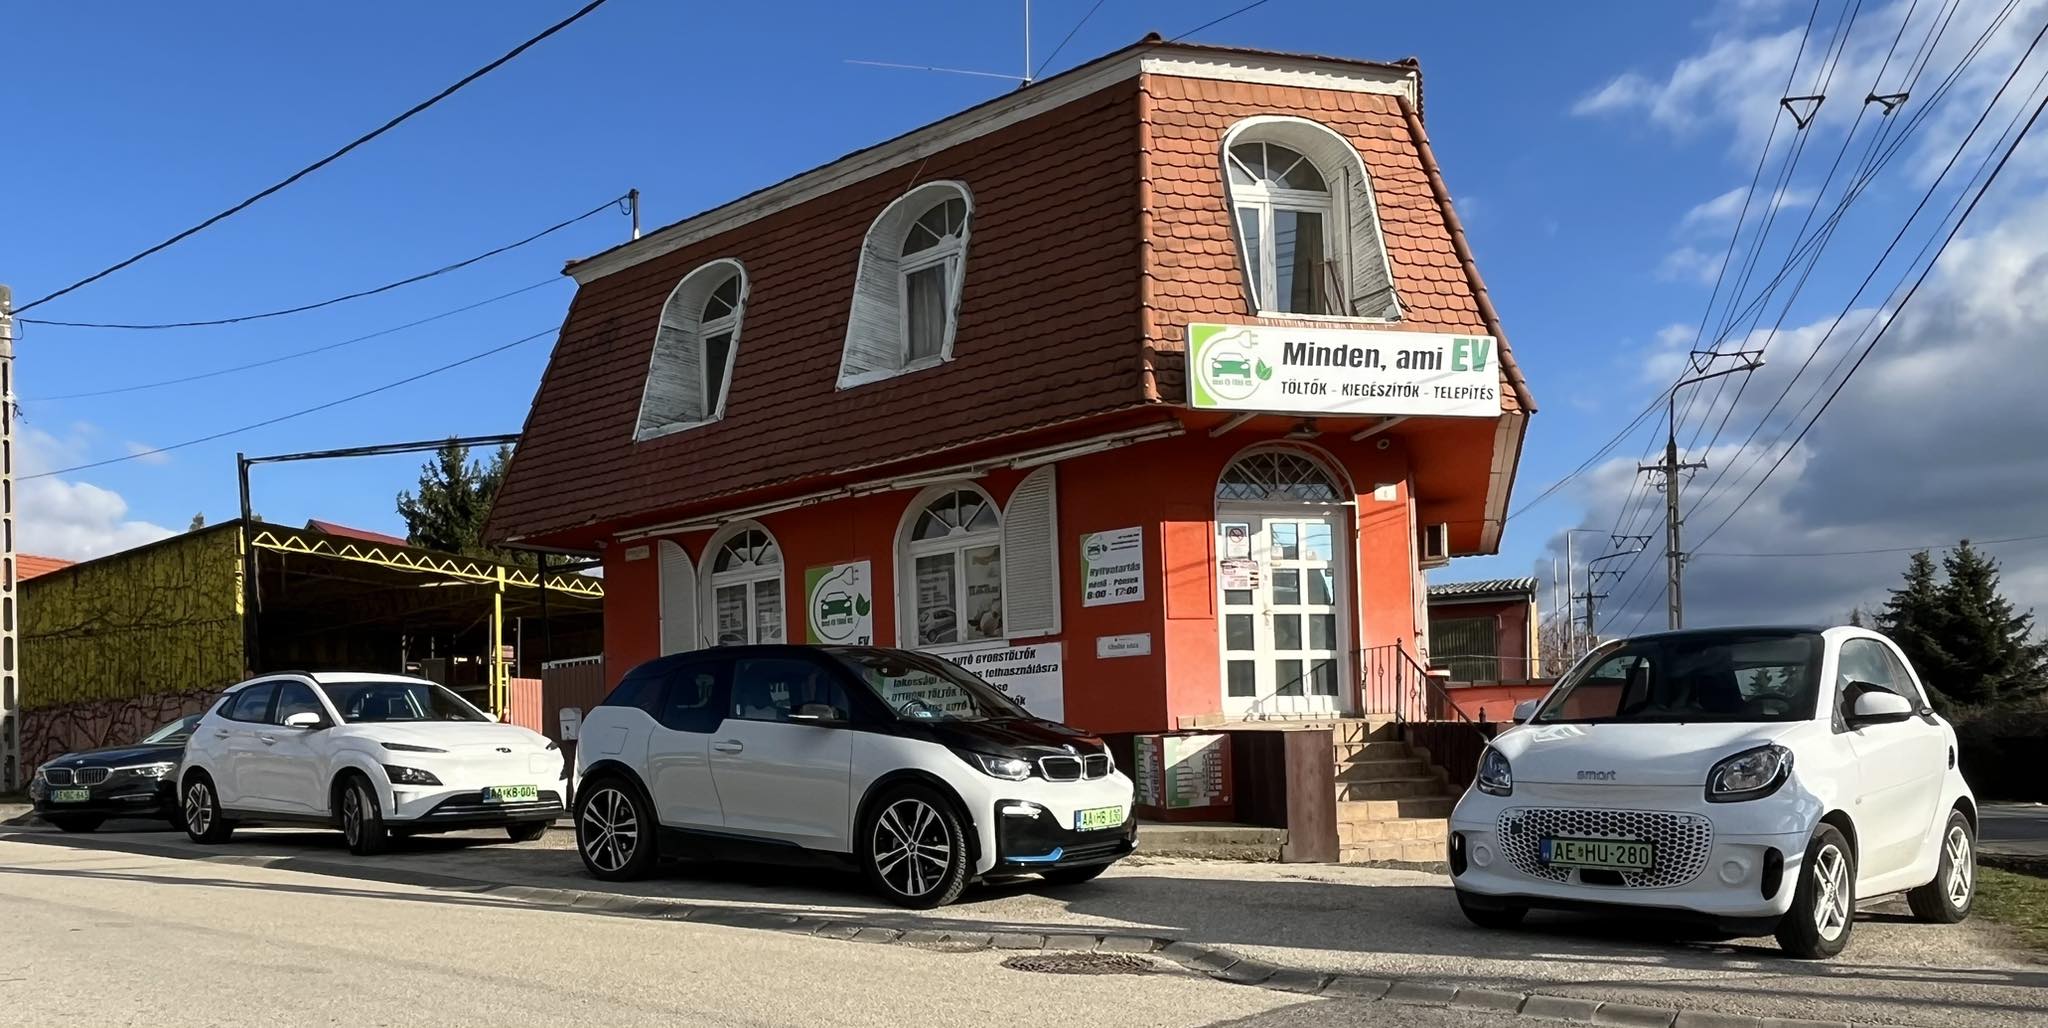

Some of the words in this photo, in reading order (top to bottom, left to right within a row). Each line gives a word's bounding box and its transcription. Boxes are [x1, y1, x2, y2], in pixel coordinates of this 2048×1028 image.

[1282, 341, 1386, 371] Minden,
[1396, 347, 1443, 370] ami
[1451, 338, 1491, 372] EV
[1281, 378, 1327, 396] TÖLTŐK
[1341, 380, 1420, 398] KIEGÉSZÍTŐK
[1434, 384, 1494, 401] TELEPÍTÉS
[1087, 590, 1107, 600] 8:00
[1115, 586, 1138, 597] 17:00
[976, 647, 1037, 664] GYORSTÖLTŐK
[985, 663, 1059, 679] felhasználásra
[1577, 770, 1616, 780] smart
[1554, 843, 1576, 861] AE
